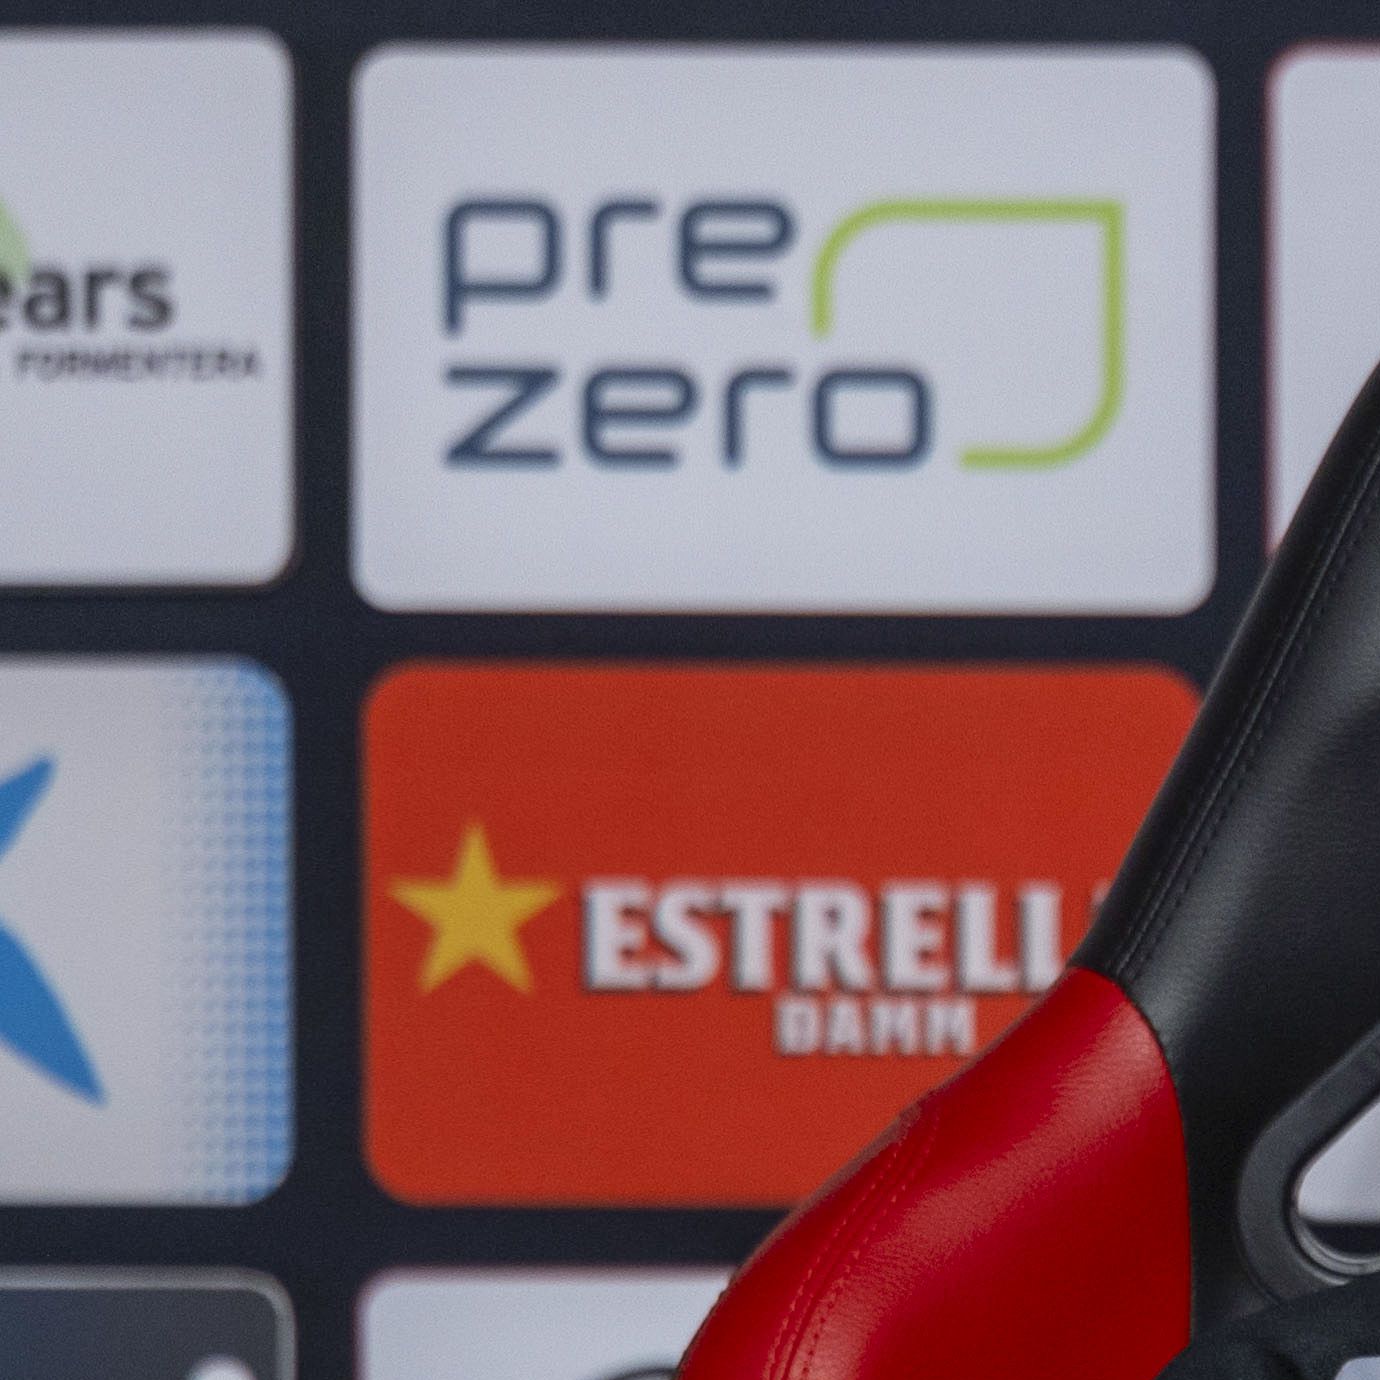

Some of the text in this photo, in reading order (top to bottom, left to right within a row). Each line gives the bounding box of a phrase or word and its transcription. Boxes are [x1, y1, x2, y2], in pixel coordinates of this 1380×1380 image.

[441, 197, 797, 337] pre
[444, 363, 935, 470] zero
[578, 876, 1112, 994] ESTRELL
[776, 996, 977, 1057] DAMM
